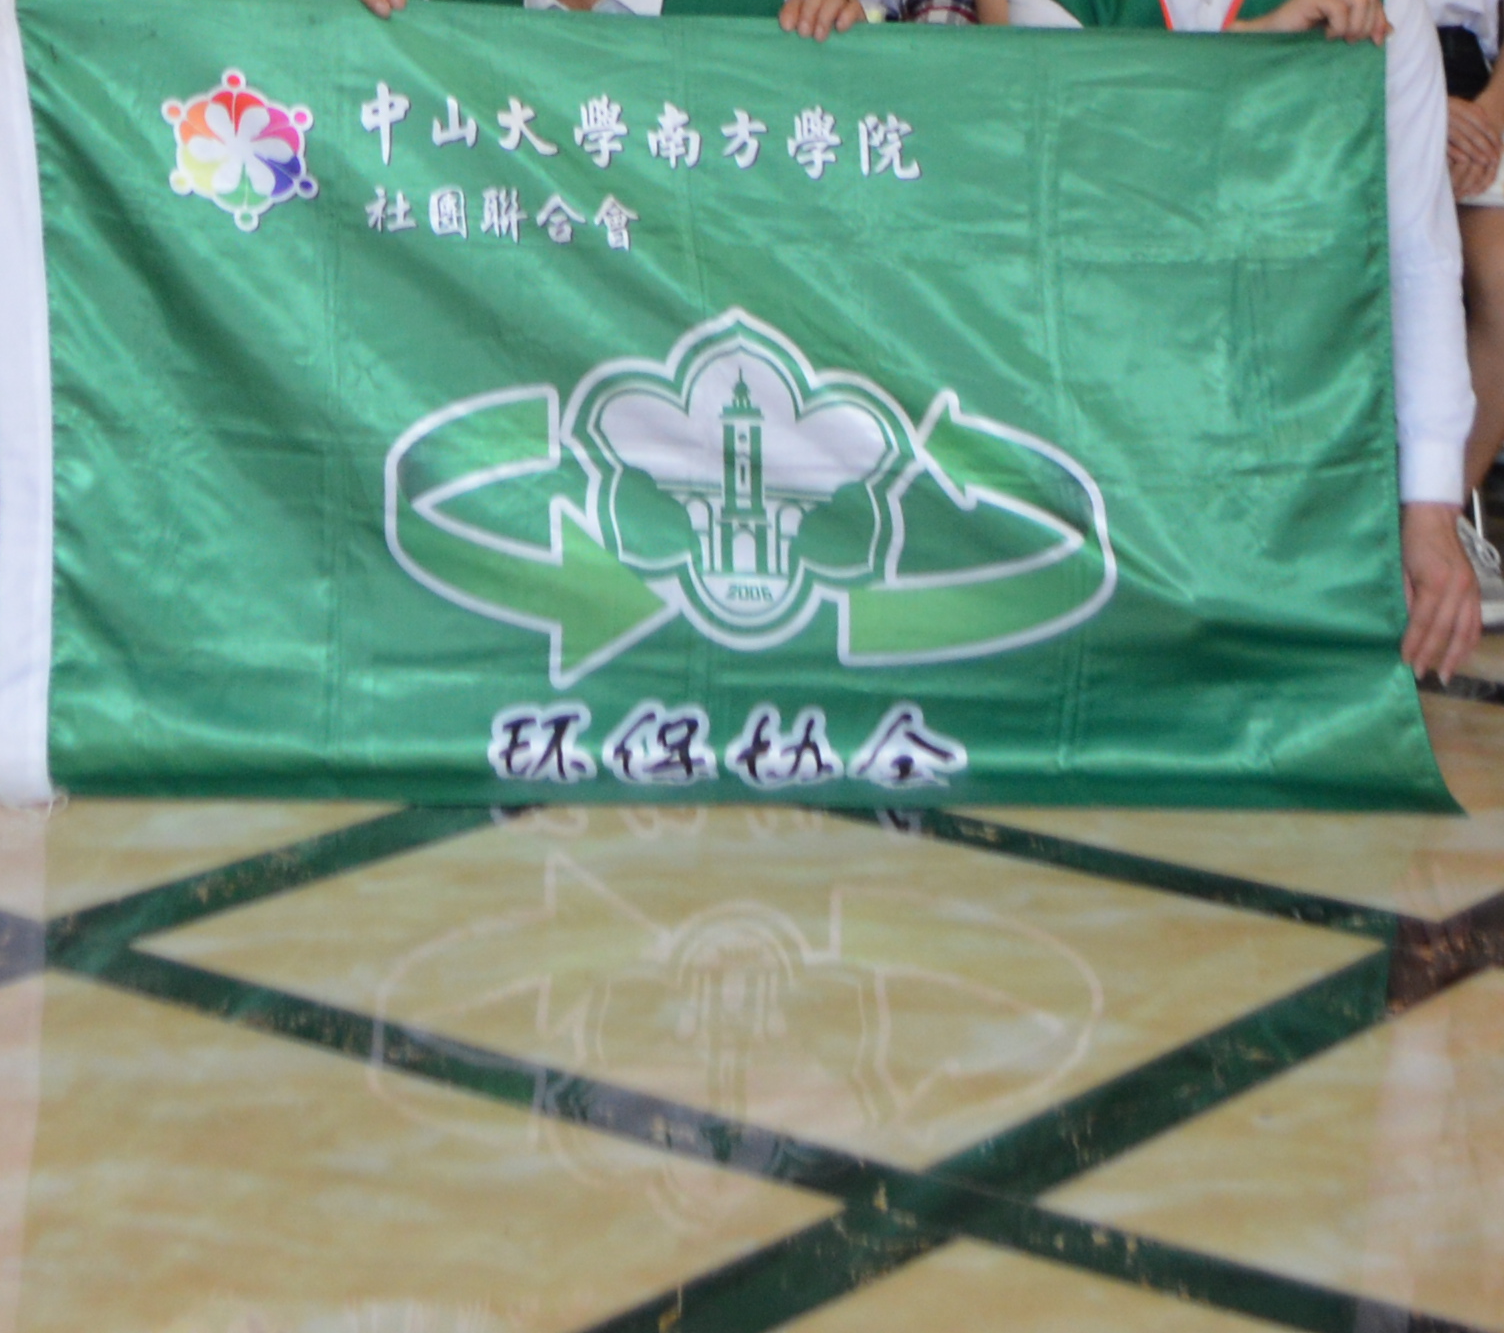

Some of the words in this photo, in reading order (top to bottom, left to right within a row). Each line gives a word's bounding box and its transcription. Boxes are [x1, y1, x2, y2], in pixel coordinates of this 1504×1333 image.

[360, 81, 922, 180] 中山大學南方學院
[364, 185, 640, 251] 社團聯合會
